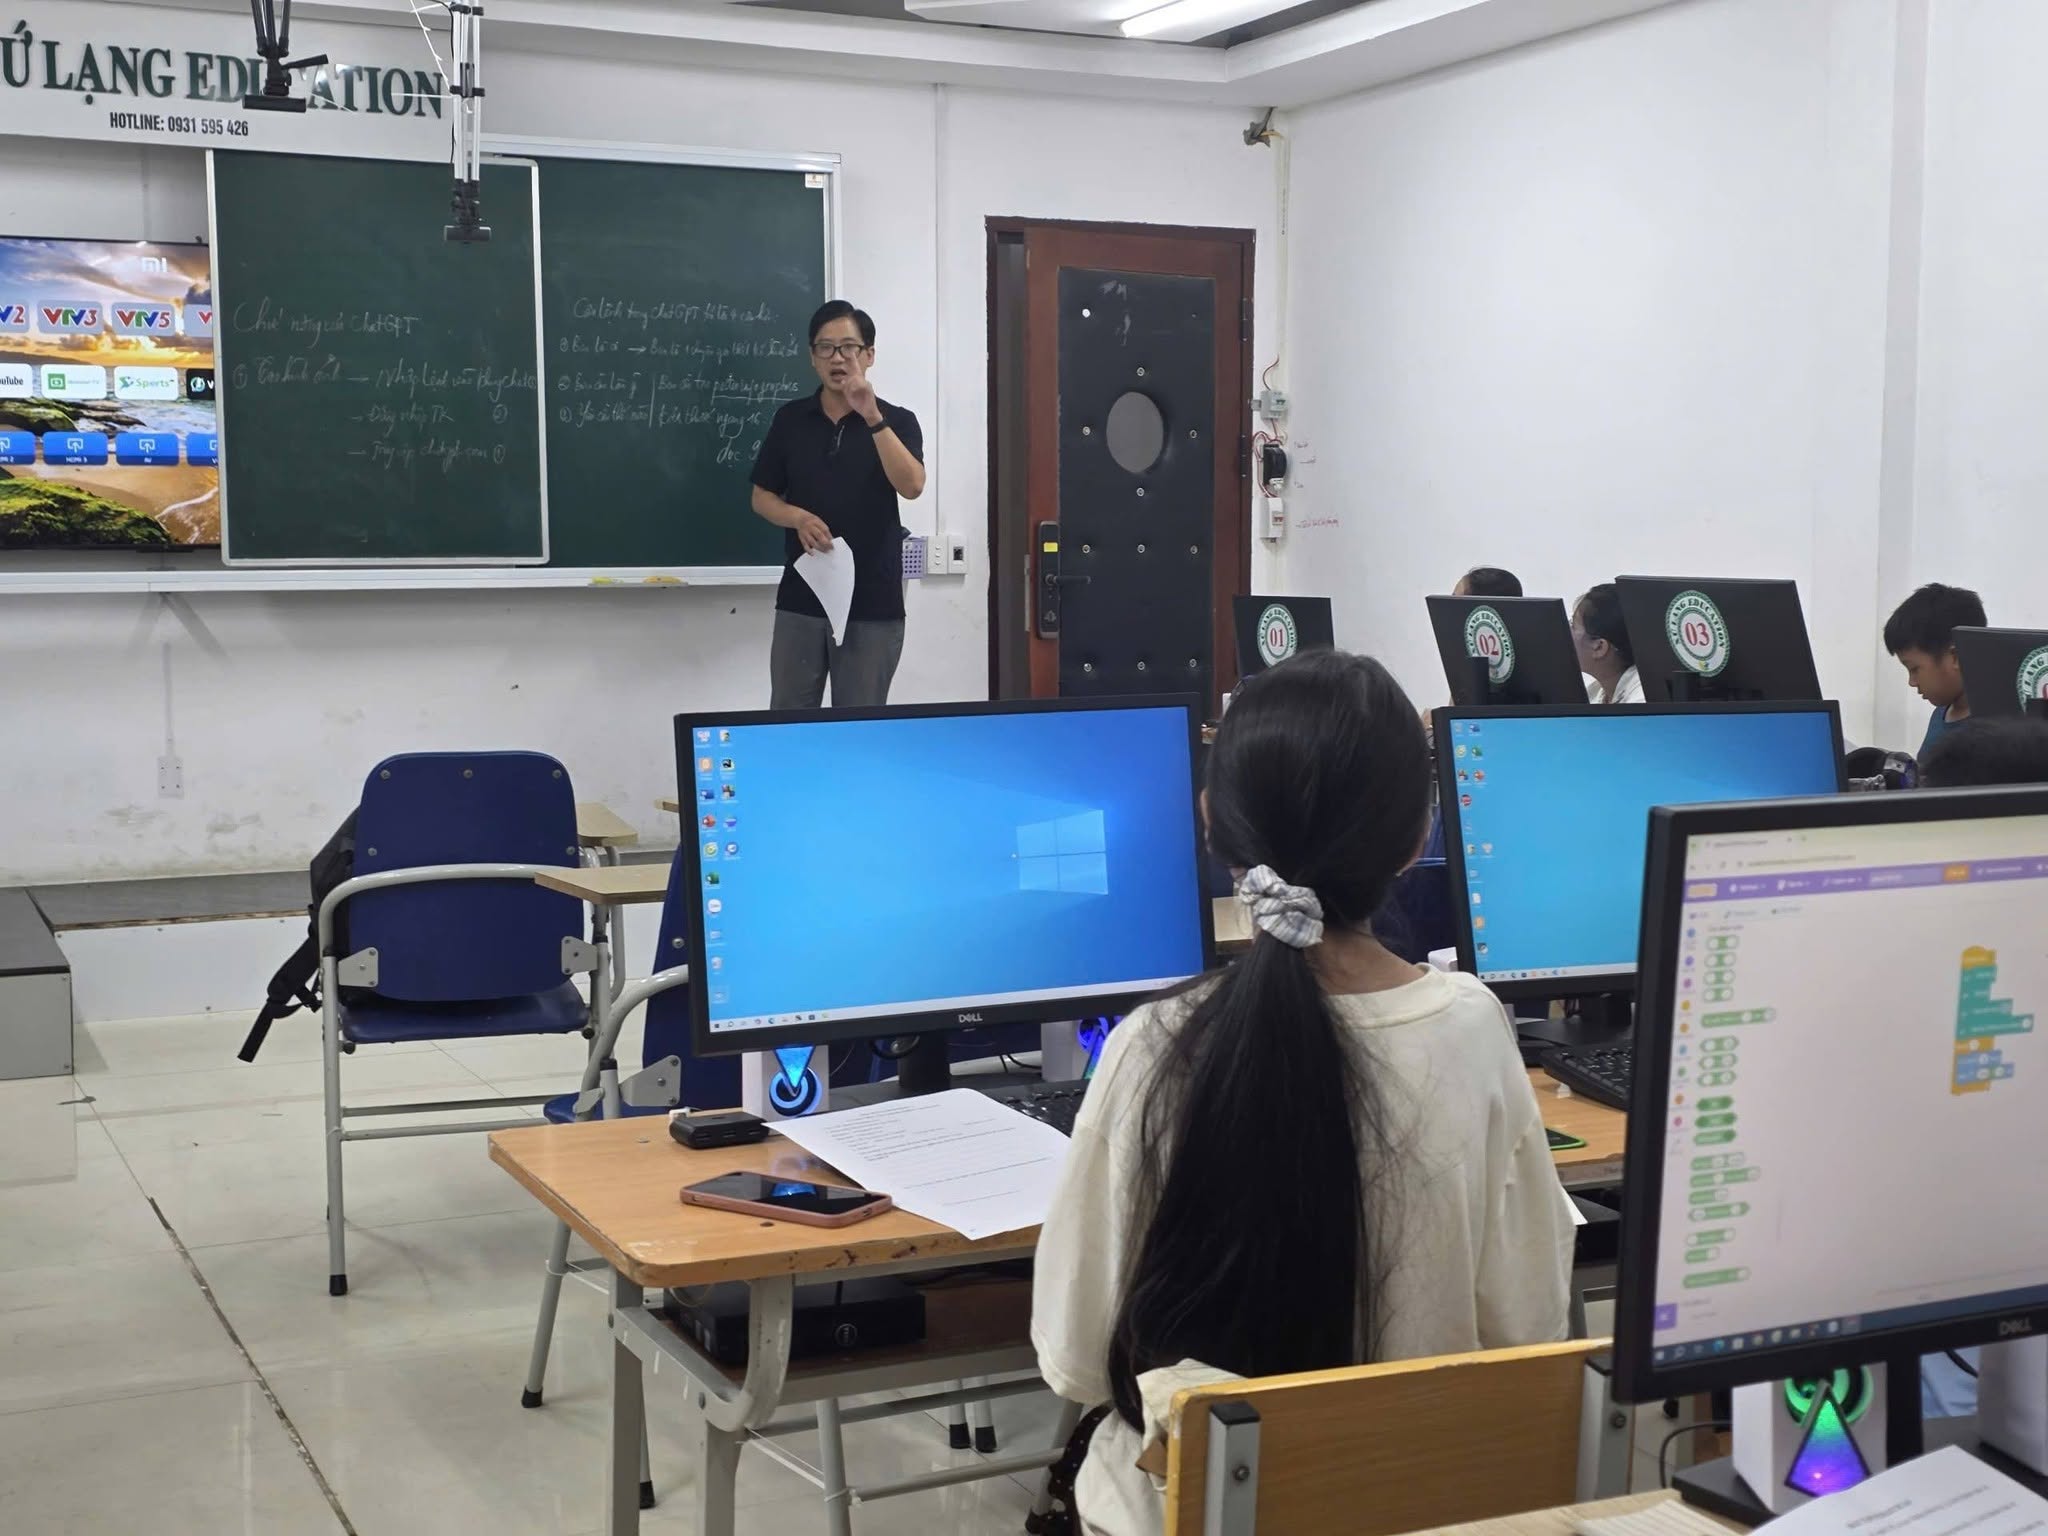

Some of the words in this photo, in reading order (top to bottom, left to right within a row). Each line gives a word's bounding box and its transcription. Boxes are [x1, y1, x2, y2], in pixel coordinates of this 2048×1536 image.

[41, 38, 176, 106] LẠNG
[110, 112, 164, 131] HOTLINE:
[167, 115, 196, 133] 0931
[201, 118, 223, 135] 595
[227, 120, 249, 136] 426
[43, 307, 97, 327] VTV3
[116, 309, 170, 329] VTV5
[1270, 627, 1284, 647] 01
[1685, 622, 1710, 646] 03
[1480, 634, 1499, 656] 02
[958, 1012, 984, 1024] DELL
